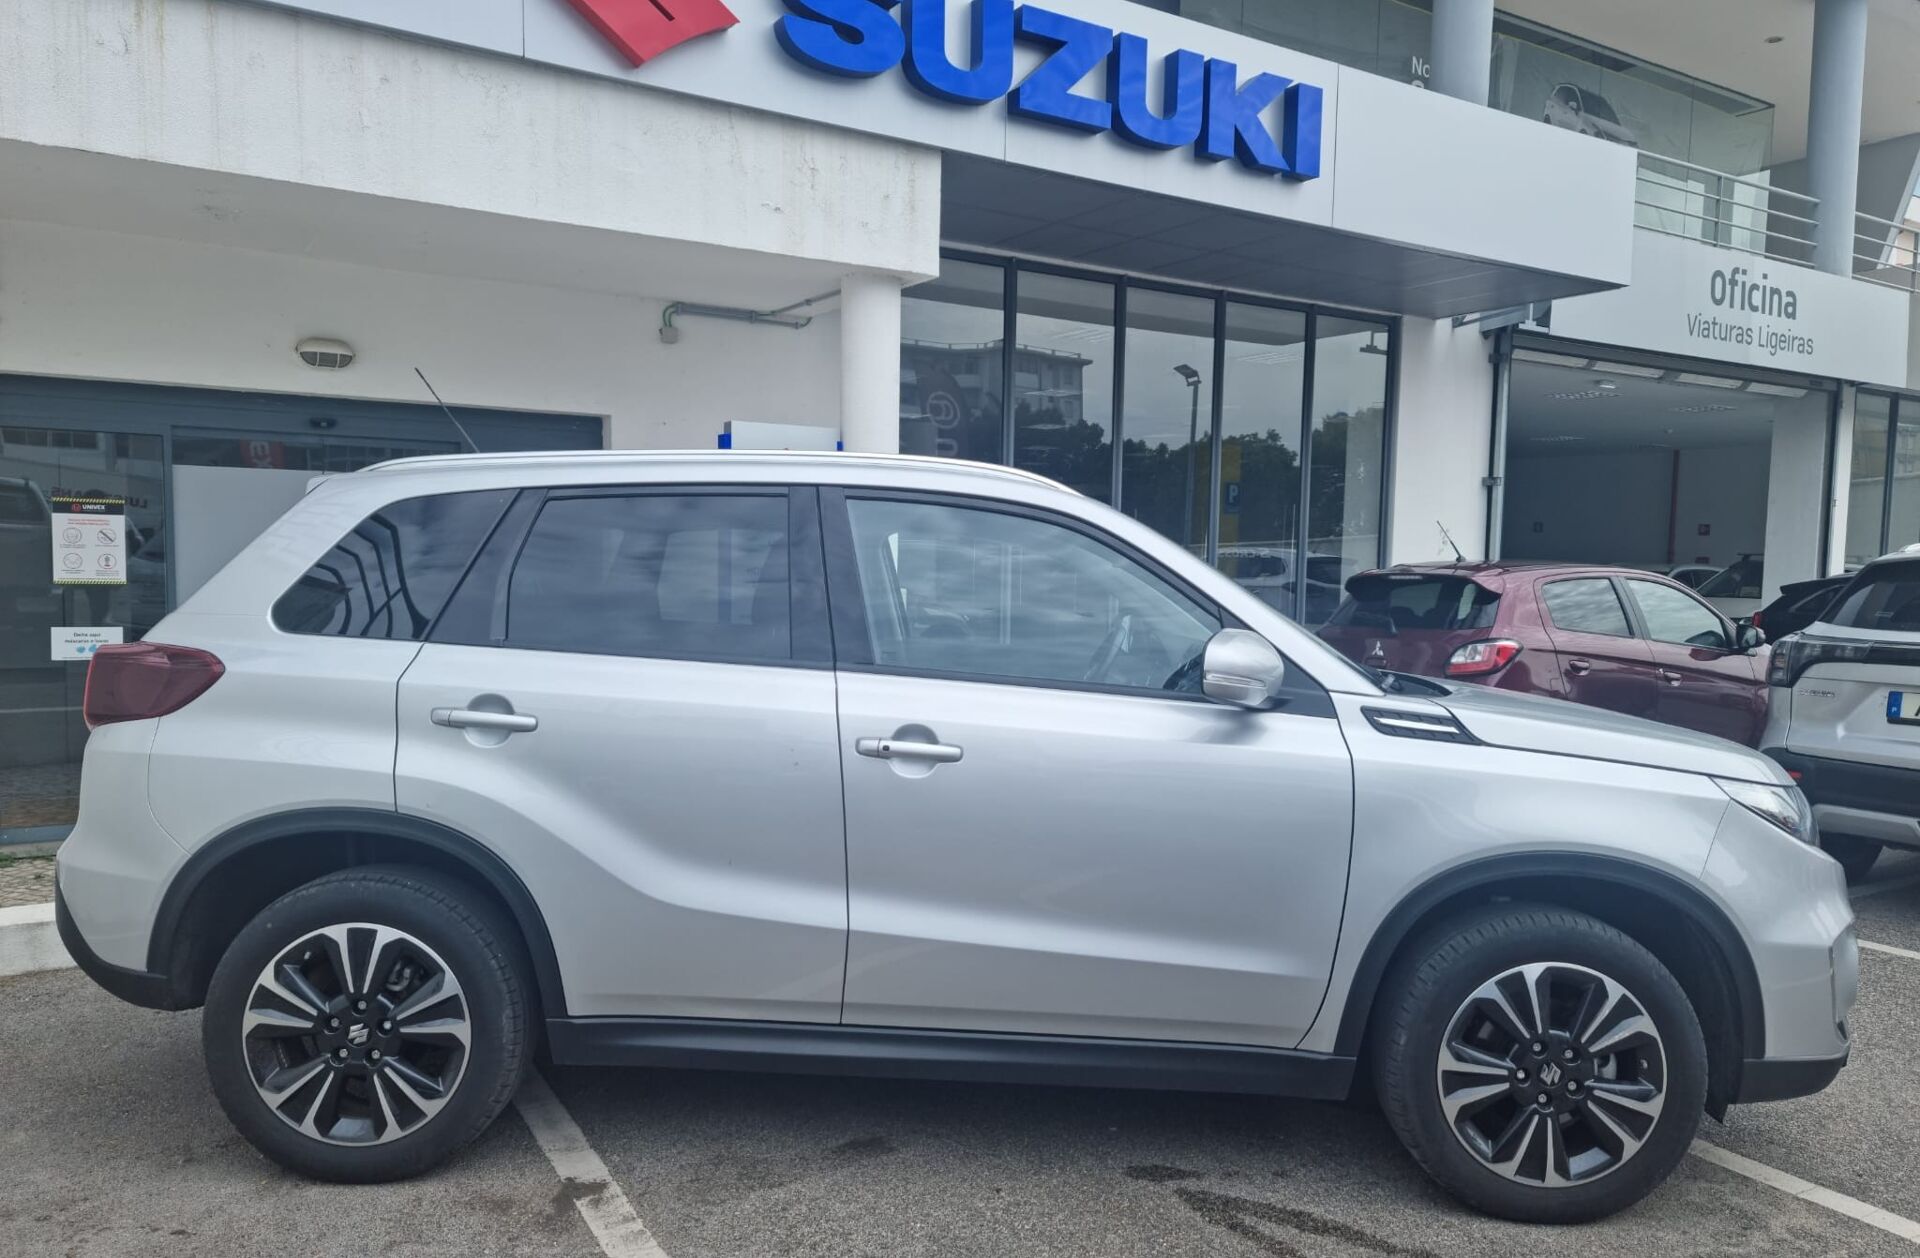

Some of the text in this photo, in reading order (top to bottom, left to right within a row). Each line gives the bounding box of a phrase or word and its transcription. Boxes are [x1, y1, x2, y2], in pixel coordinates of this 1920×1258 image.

[774, 0, 1324, 182] SUZUKI
[1711, 267, 1797, 320] Oficina
[1687, 313, 1814, 356] Viaturas Ligeiras
